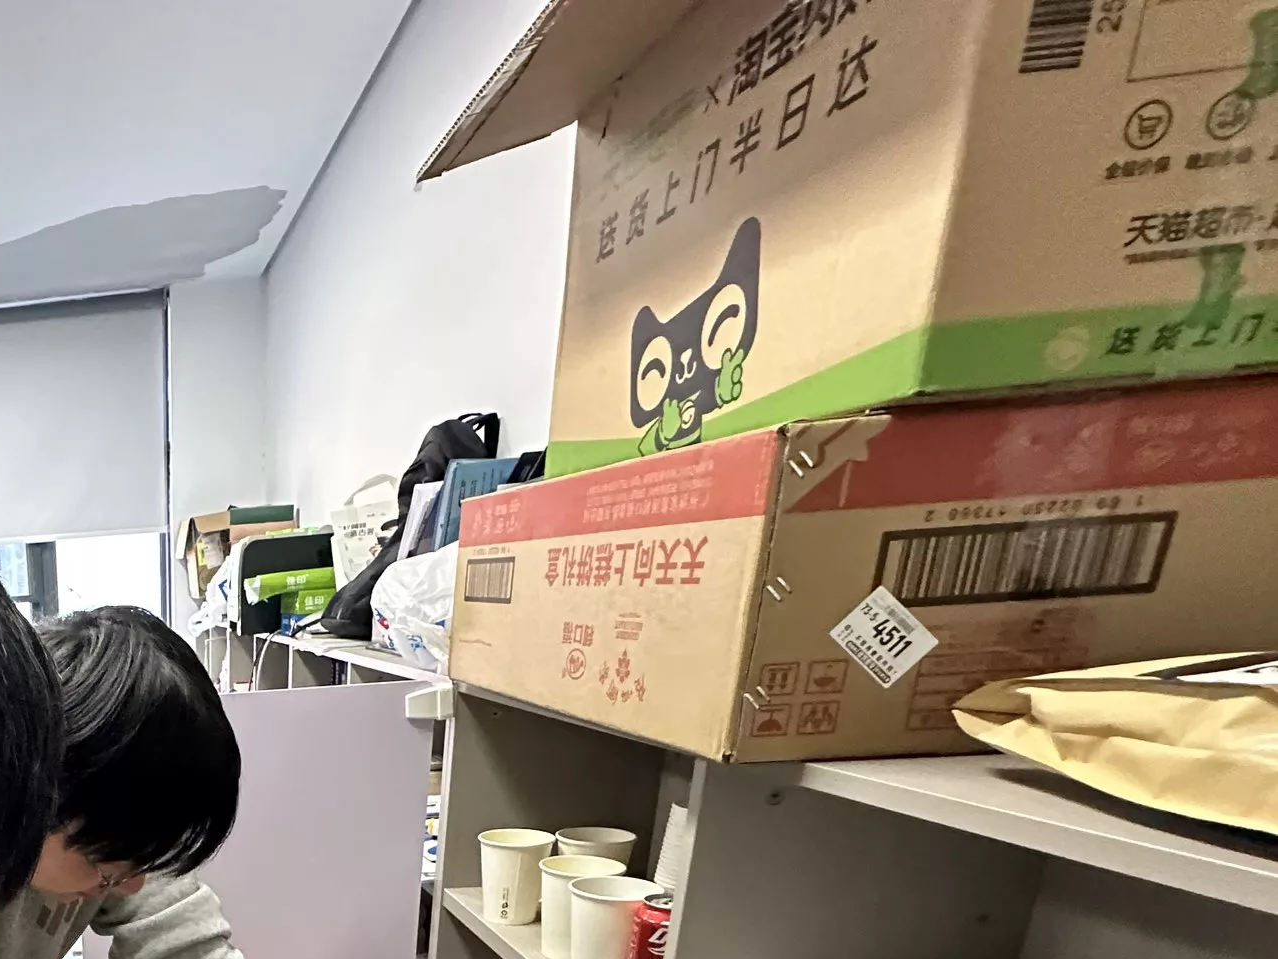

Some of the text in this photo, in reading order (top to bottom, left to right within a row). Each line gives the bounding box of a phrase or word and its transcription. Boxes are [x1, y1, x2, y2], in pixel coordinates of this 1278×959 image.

[727, 0, 857, 106] 淘宝闪
[595, 34, 879, 264] 送货上门半日达
[1123, 203, 1278, 248] 天猫超市·
[1102, 314, 1278, 359] 送货上门
[545, 535, 709, 588] 天天向上糕饼礼盒
[872, 618, 913, 658] 4511
